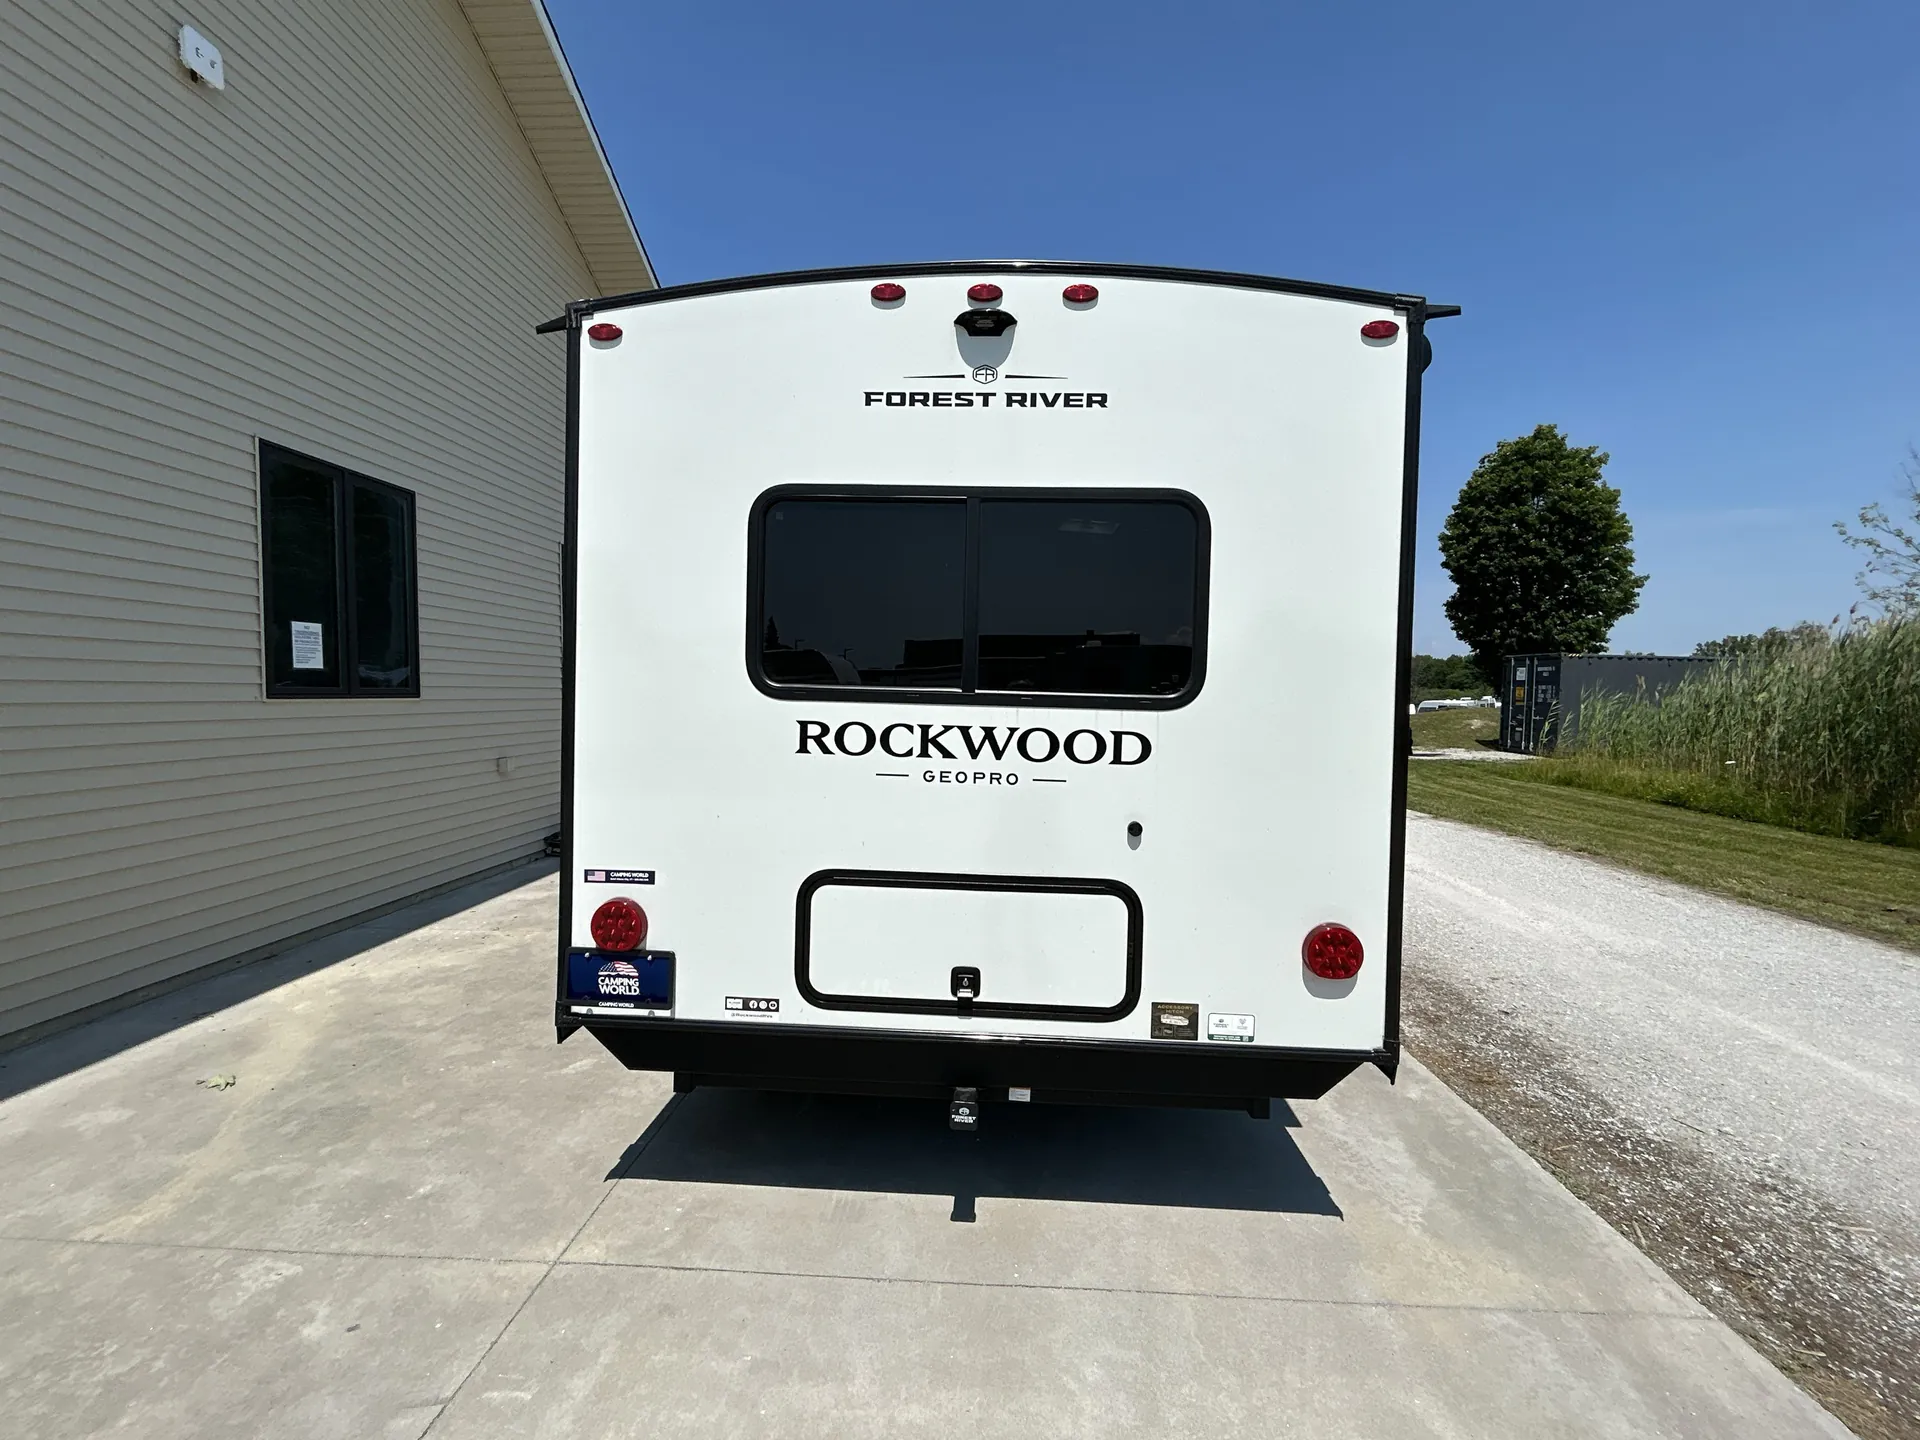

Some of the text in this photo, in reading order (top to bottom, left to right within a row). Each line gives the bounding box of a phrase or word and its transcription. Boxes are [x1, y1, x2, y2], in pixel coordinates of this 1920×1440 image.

[863, 391, 1109, 408] FOREST RIVER
[795, 719, 1152, 766] ROCKWOOD
[922, 770, 1019, 786] GEOPRO
[598, 976, 639, 987] CAMPING
[599, 985, 640, 996] WORLD
